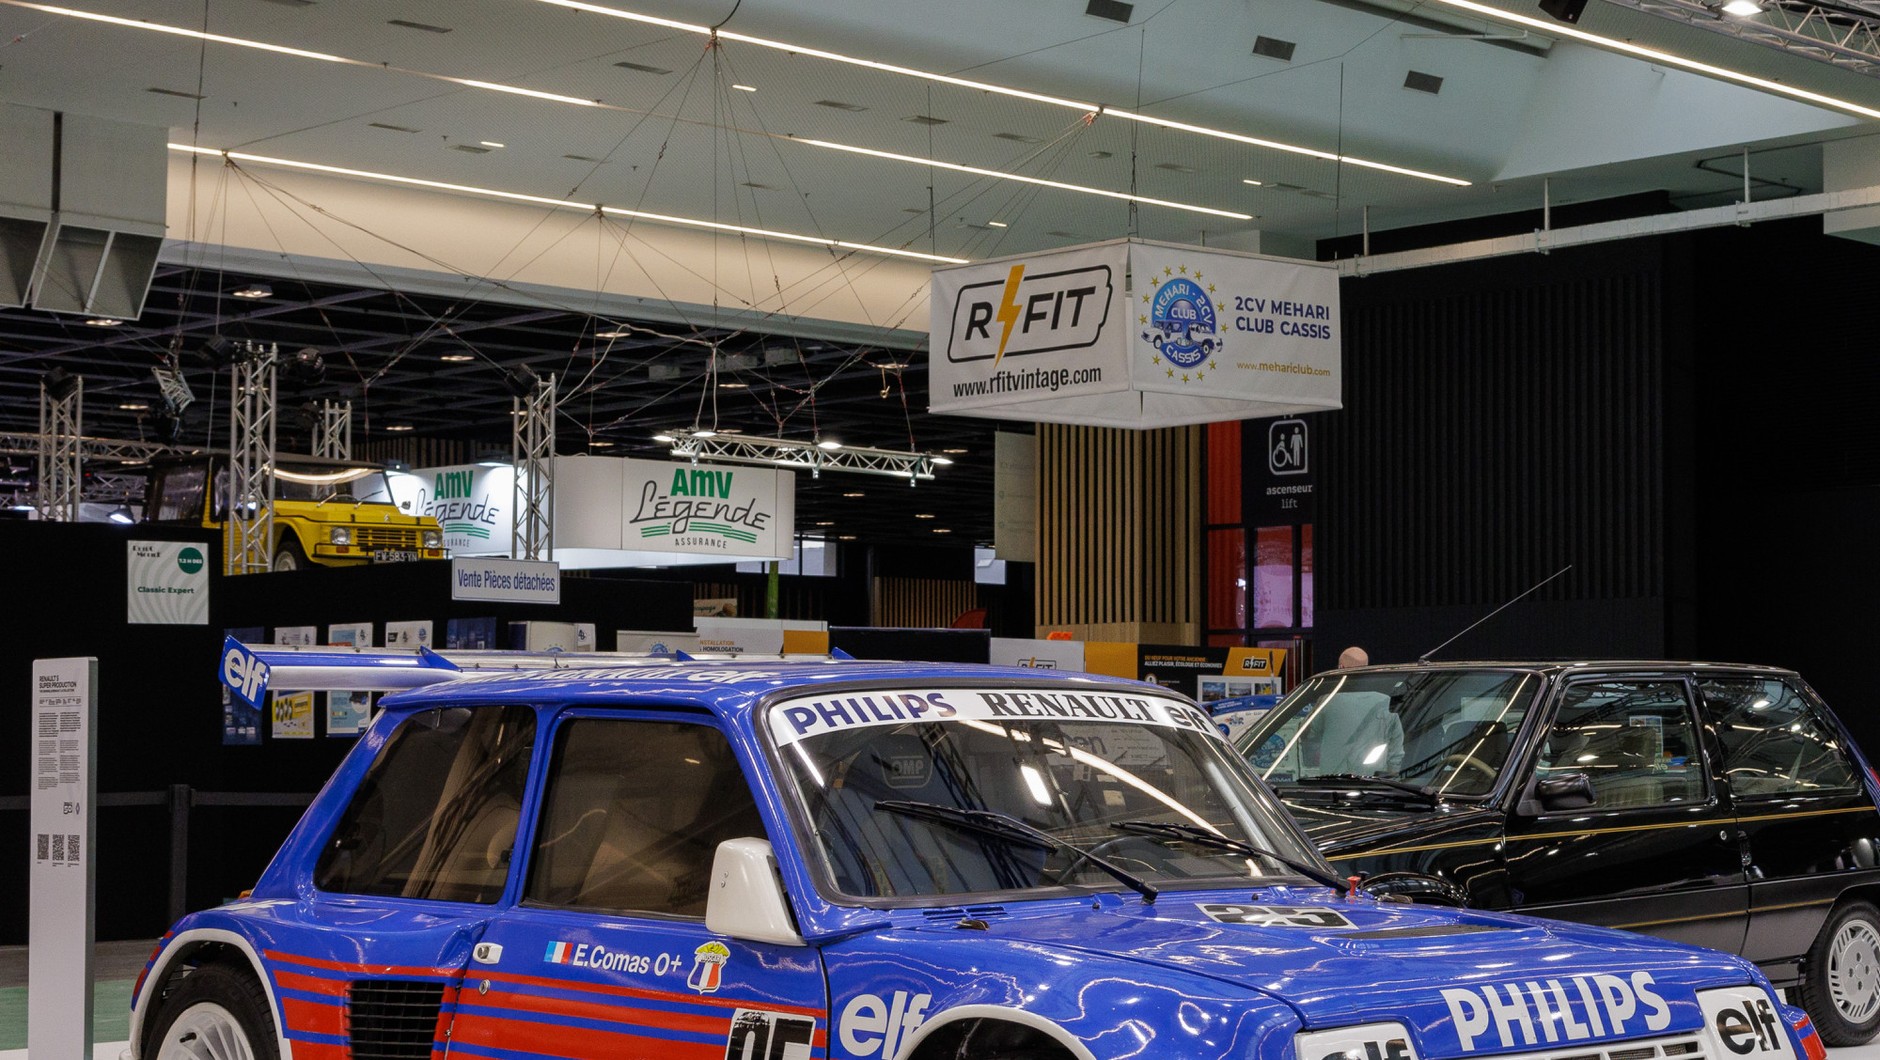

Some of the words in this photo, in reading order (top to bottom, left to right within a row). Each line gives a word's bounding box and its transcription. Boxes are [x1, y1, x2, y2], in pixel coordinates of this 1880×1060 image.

[1155, 284, 1189, 318] MEHARI
[1196, 296, 1212, 324] 2CV
[1171, 308, 1197, 320] CLUB
[1235, 296, 1265, 313] 2CV
[1271, 300, 1329, 320] MEHARI
[1236, 316, 1274, 334] CLUB
[1280, 321, 1331, 340] CASSIS
[1166, 344, 1201, 363] CASSIS
[1236, 361, 1331, 376] www.mehariclub.com
[953, 367, 1102, 398] www.rfitvintage.com
[1266, 484, 1313, 495] ascenseur
[1281, 498, 1298, 509] lift
[675, 537, 727, 549] ASSURANCE
[167, 587, 194, 595] Expert
[458, 569, 482, 587] Vente
[484, 570, 511, 589] Pièces
[513, 572, 555, 591] détachées
[224, 648, 266, 702] elf
[783, 693, 957, 735] PHILIPS
[977, 692, 1159, 723] RENAULT
[1166, 706, 1210, 733] elf
[1204, 905, 1349, 927] 25
[573, 944, 651, 975] E.Comas
[1439, 971, 1671, 1051] PHILIPS
[839, 990, 932, 1060] elf
[1716, 999, 1781, 1055] elf
